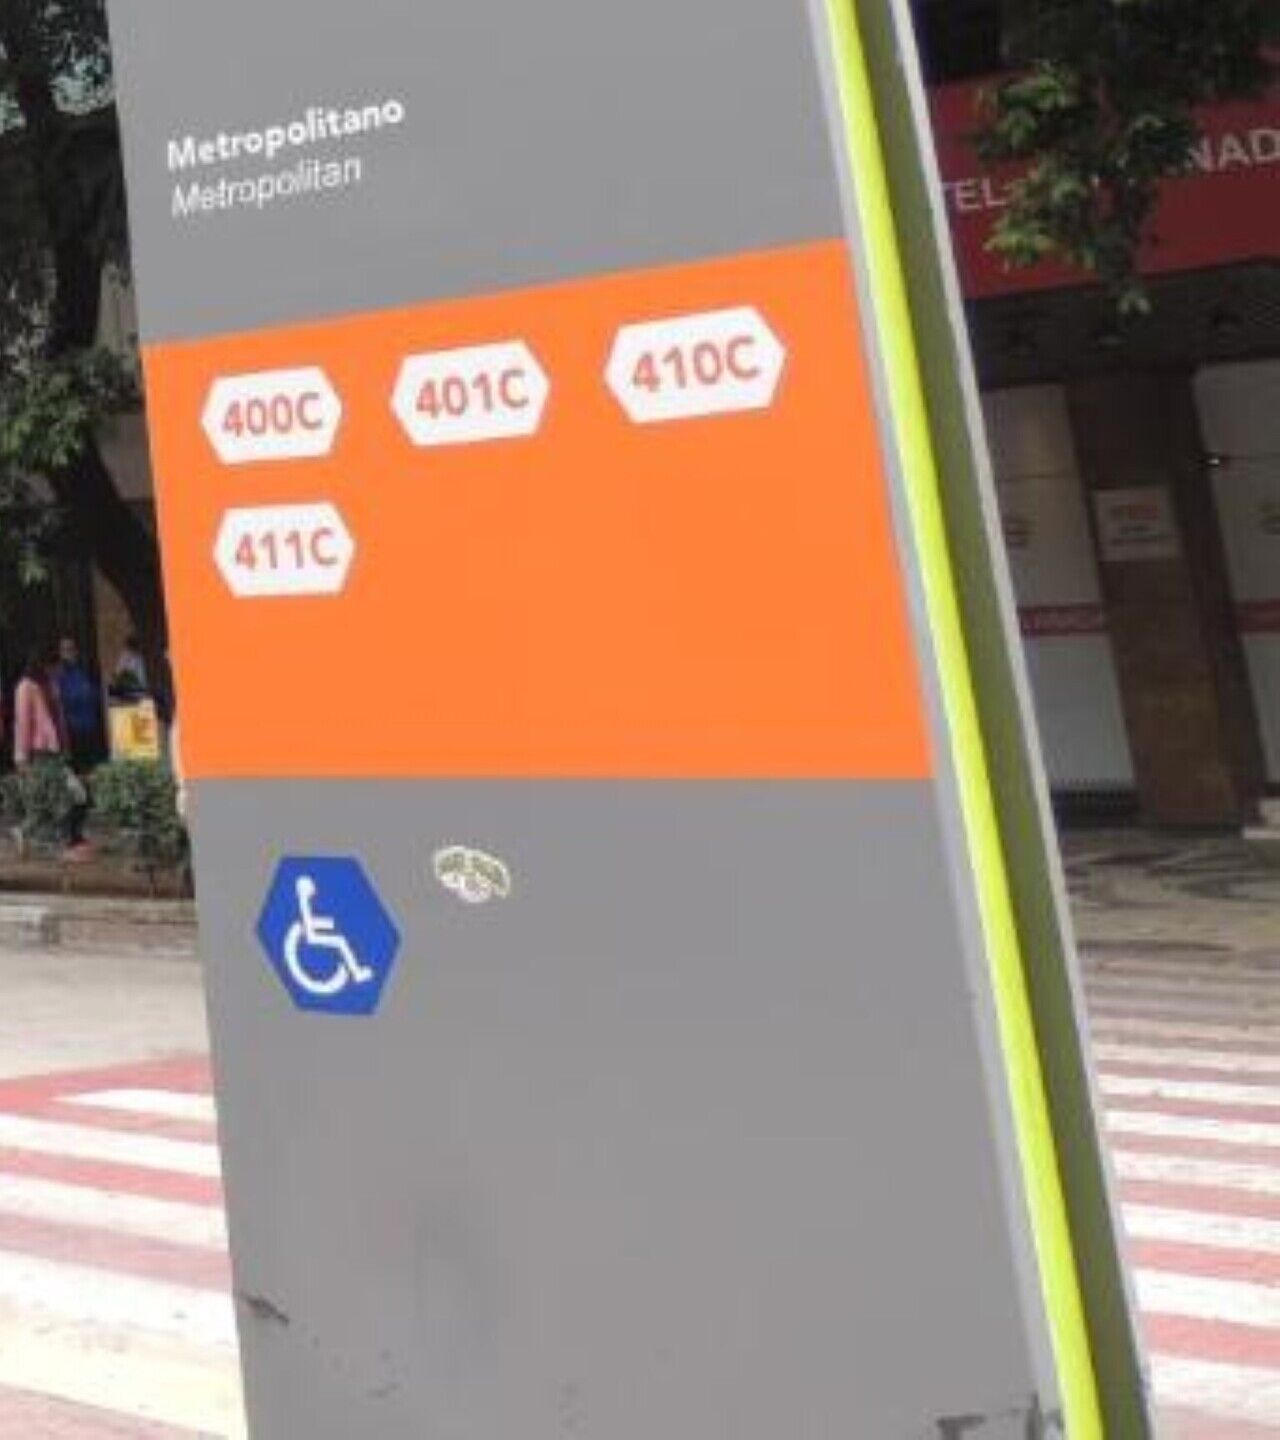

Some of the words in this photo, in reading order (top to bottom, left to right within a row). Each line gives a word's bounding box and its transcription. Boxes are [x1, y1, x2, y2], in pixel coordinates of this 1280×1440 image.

[166, 99, 406, 171] Metropolitano
[171, 157, 362, 218] Metropolitan
[630, 334, 762, 393] 410C
[222, 392, 325, 438] 400C
[415, 368, 530, 419] 401C
[233, 527, 339, 569] 411C
